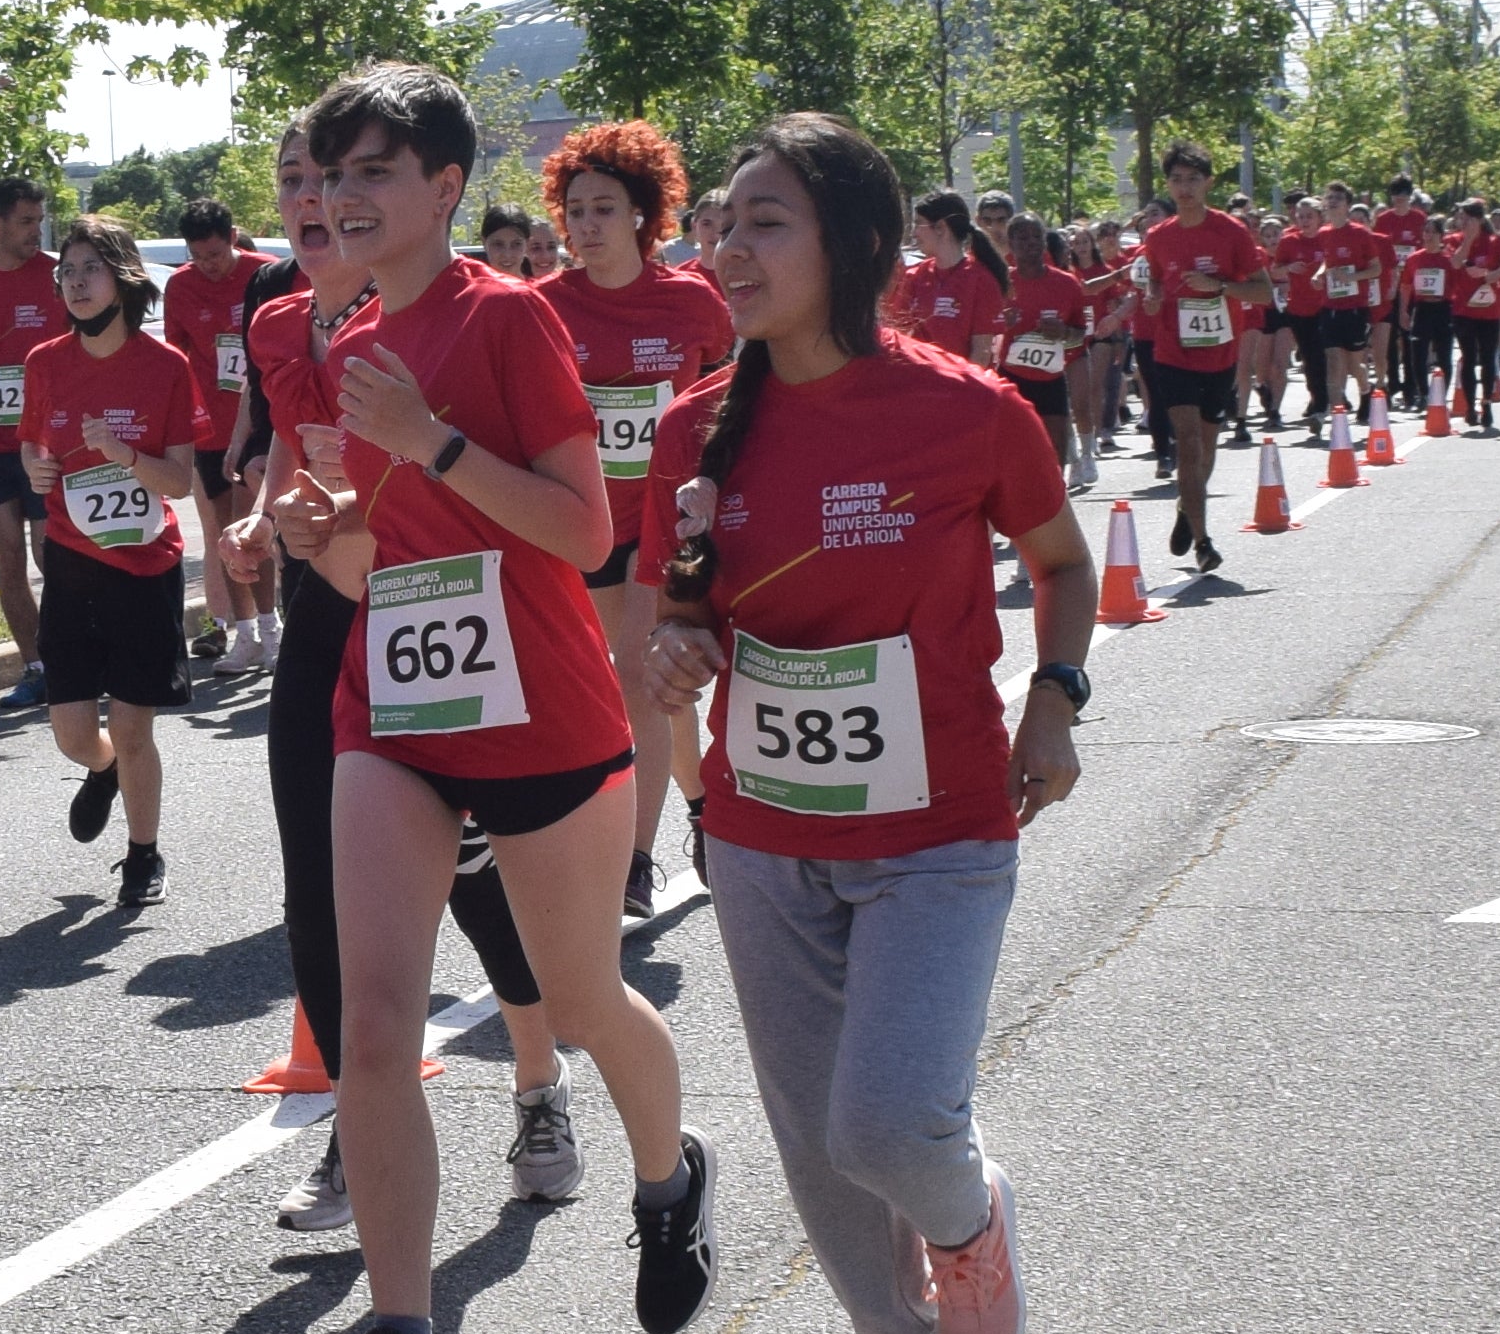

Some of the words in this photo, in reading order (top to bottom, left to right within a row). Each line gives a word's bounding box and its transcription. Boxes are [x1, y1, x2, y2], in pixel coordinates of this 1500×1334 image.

[1189, 315, 1225, 333] 411
[1017, 347, 1056, 367] 407
[597, 417, 656, 451] 194
[822, 482, 887, 500] CARRERA
[85, 487, 149, 523] 229
[822, 498, 881, 516] CAMPUS
[823, 513, 915, 533] UNIVERSIDAD
[823, 533, 841, 549] DE
[844, 533, 861, 547] LA
[865, 528, 904, 545] RIOJA
[372, 574, 406, 592] CARRERA
[406, 570, 440, 587] CAMPUS
[416, 585, 431, 599] DE
[431, 583, 446, 596] LA
[447, 578, 475, 594] RIOJA
[386, 615, 496, 684] 662
[743, 646, 777, 668] CARRERA
[778, 660, 827, 673] CAMPUS
[740, 658, 797, 685] UNIVERSIDAD
[799, 673, 815, 685] DE
[816, 673, 832, 685] LA
[834, 668, 866, 684] RIOJA
[756, 702, 885, 765] 583
